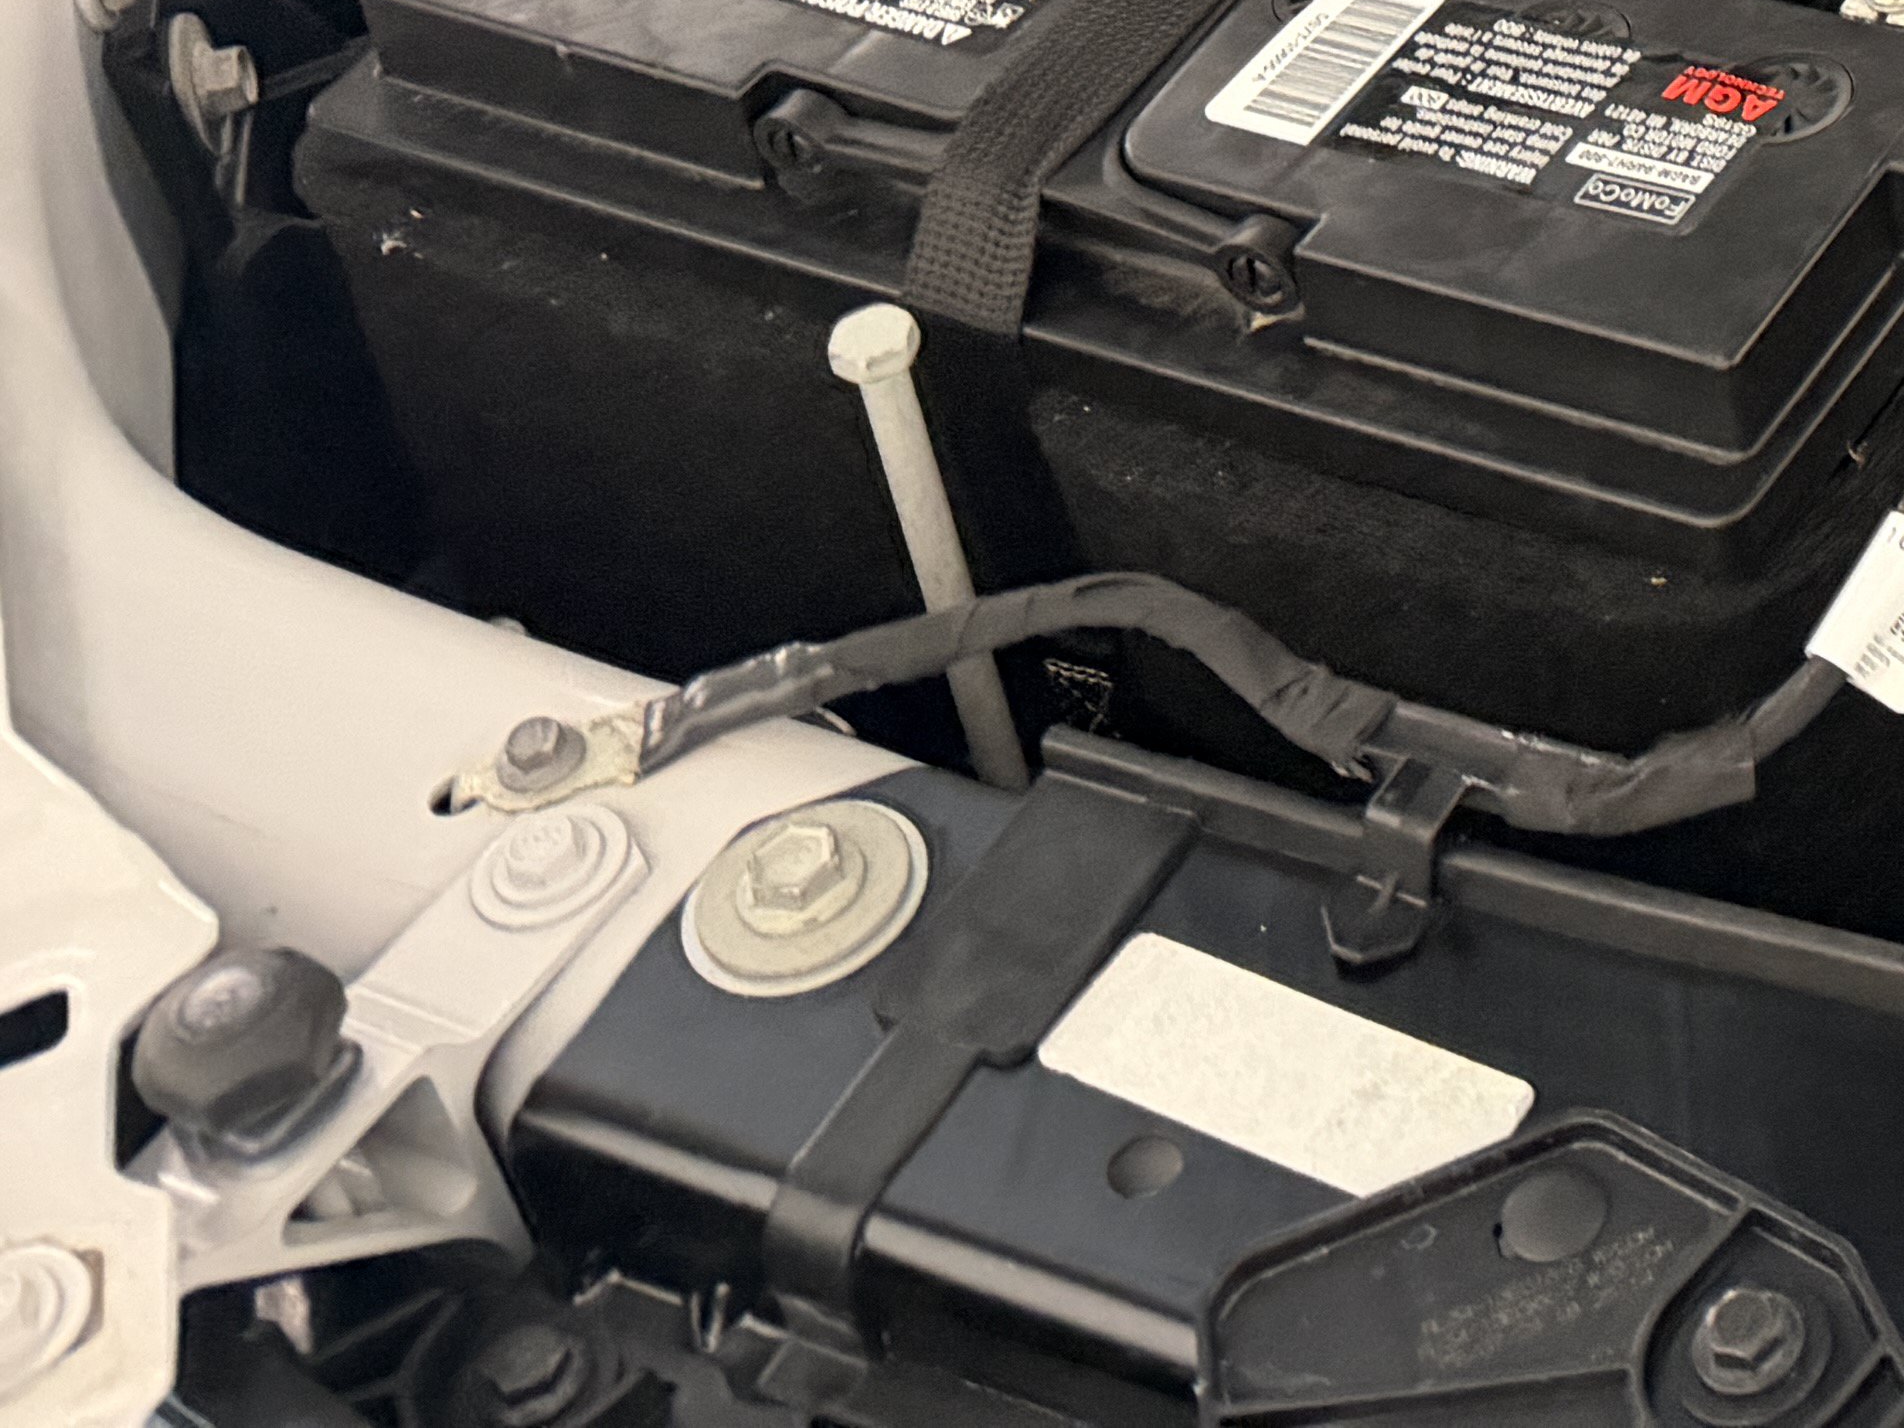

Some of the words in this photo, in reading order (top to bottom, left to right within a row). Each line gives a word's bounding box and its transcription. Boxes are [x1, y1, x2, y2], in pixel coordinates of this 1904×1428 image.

[1661, 74, 1778, 121] AGM
[1645, 129, 1697, 150] MOTOR
[1696, 141, 1737, 160] FORD
[1588, 182, 1685, 216] FoMoCo
